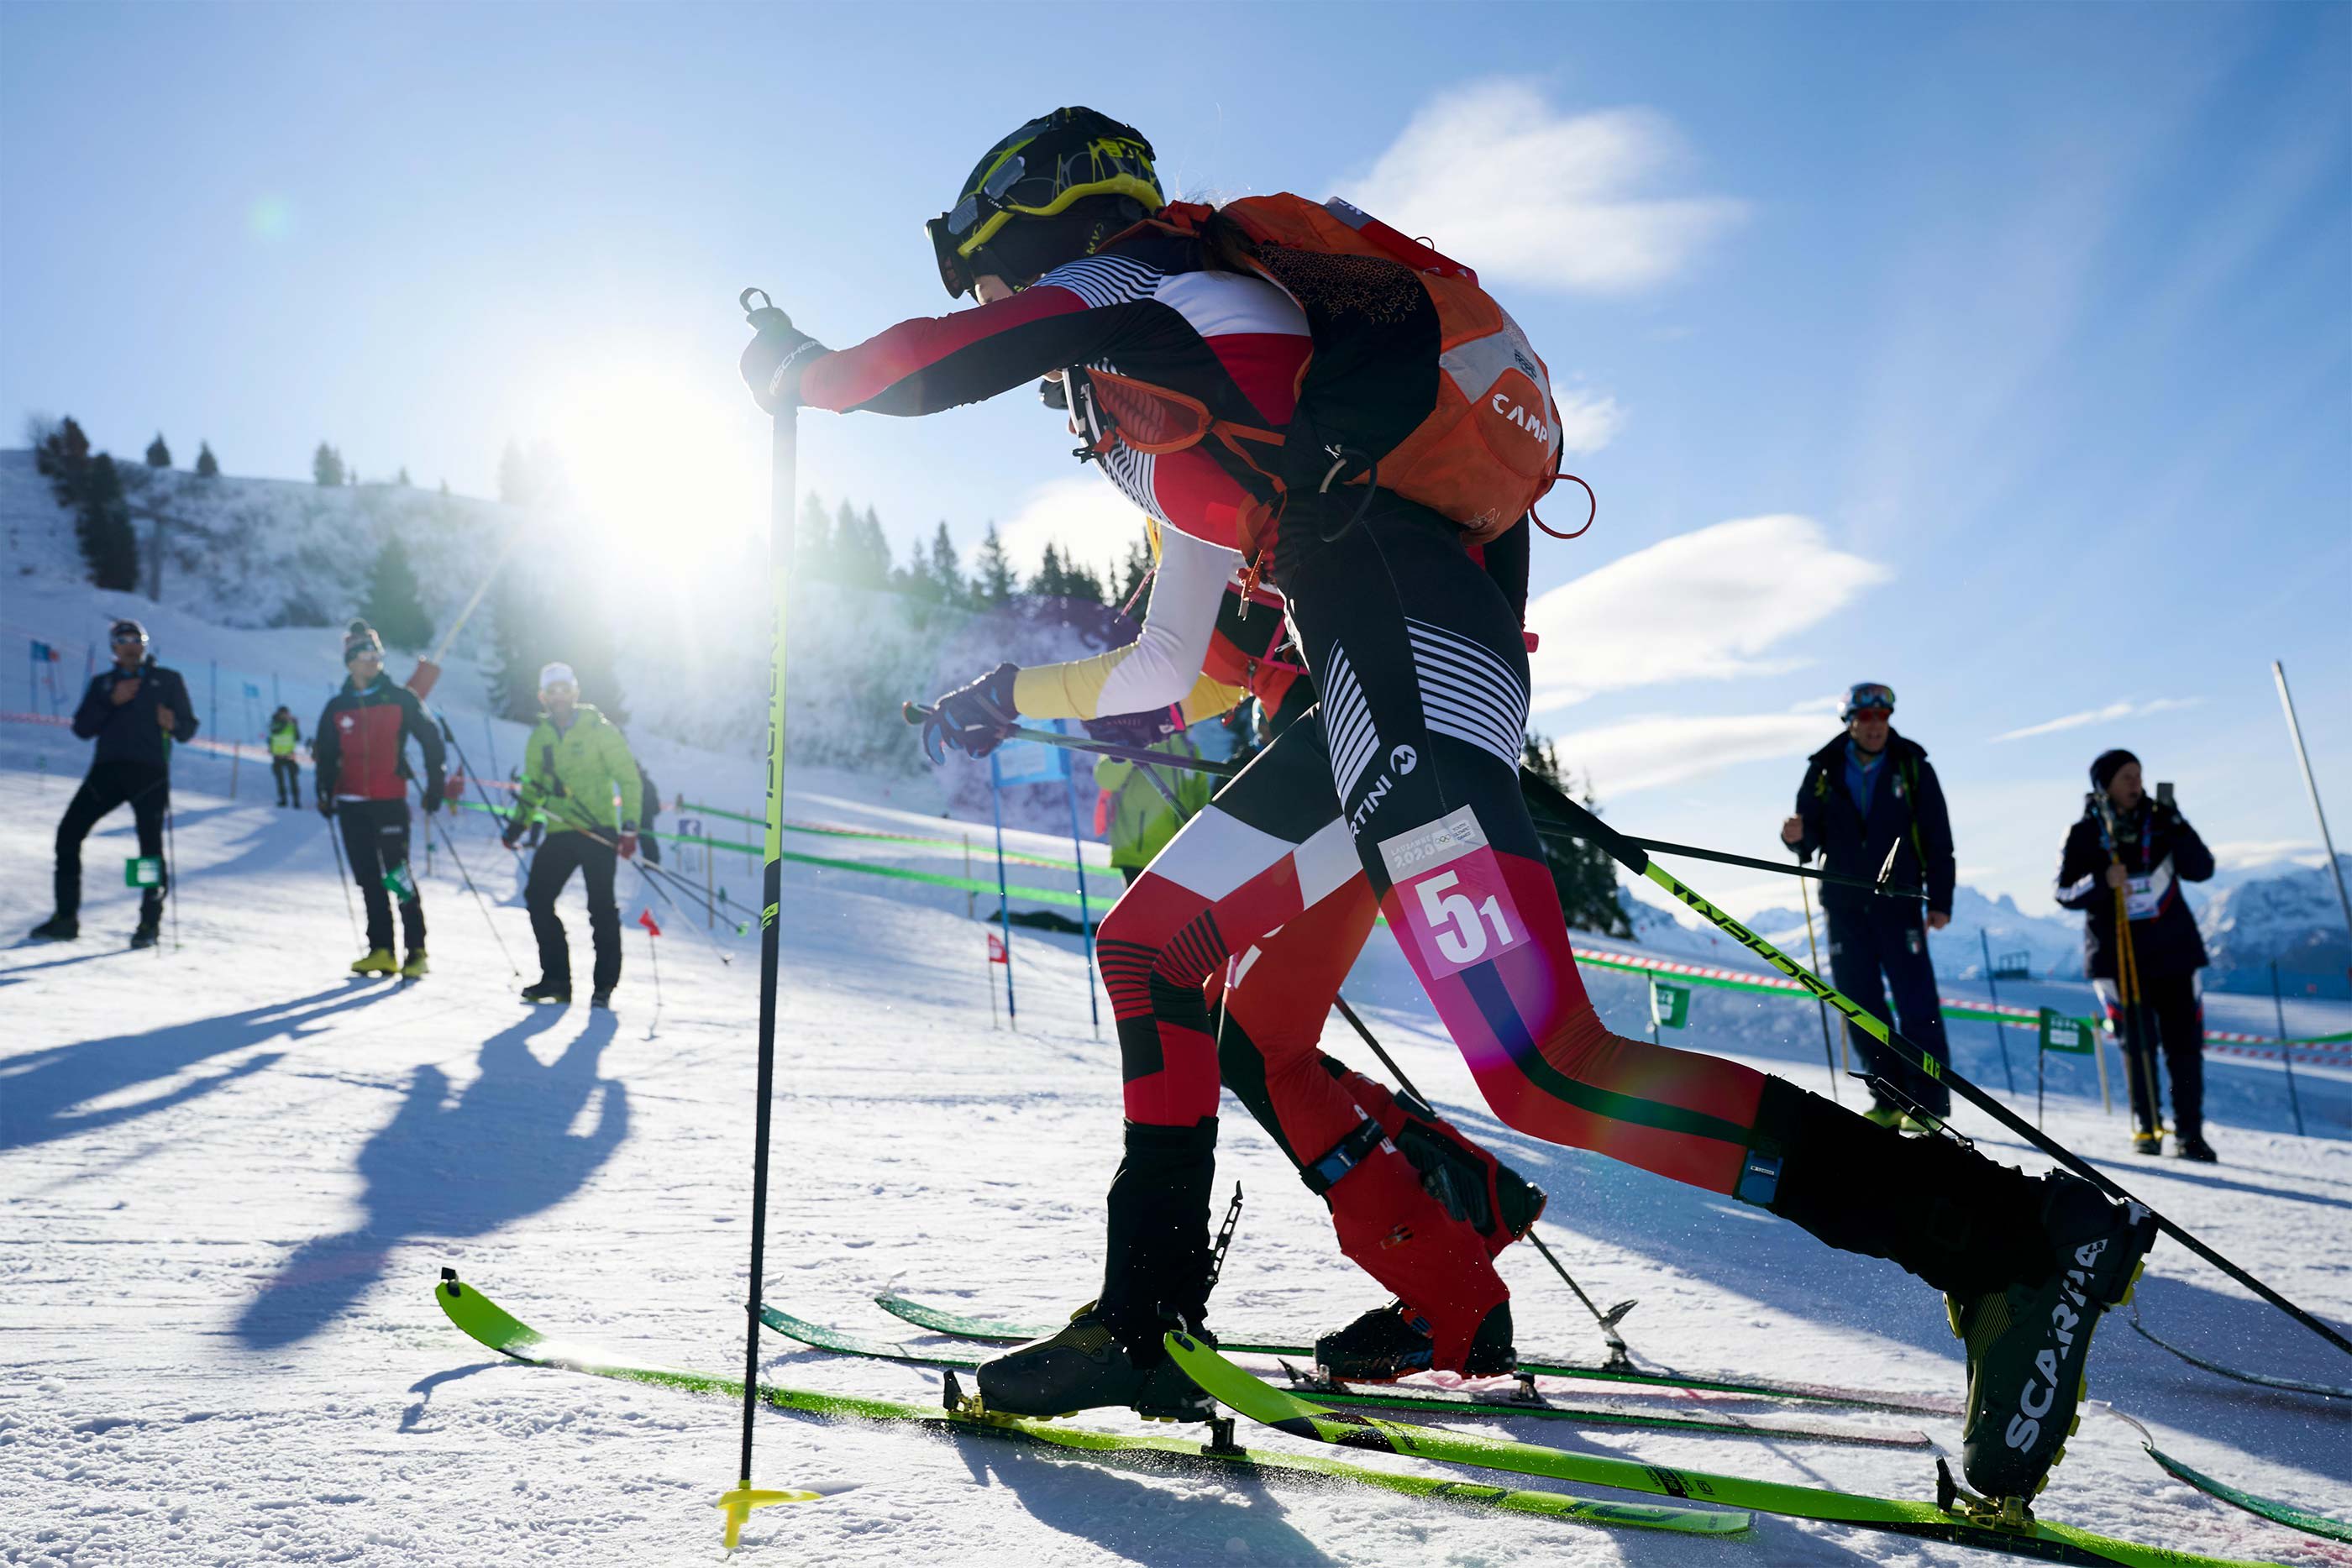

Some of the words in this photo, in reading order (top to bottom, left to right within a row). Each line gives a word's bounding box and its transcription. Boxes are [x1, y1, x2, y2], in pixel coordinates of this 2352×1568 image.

[1492, 393, 1548, 443] CAMP
[1697, 904, 1863, 1018] FISCHER
[2005, 1238, 2108, 1455] SCARPA
